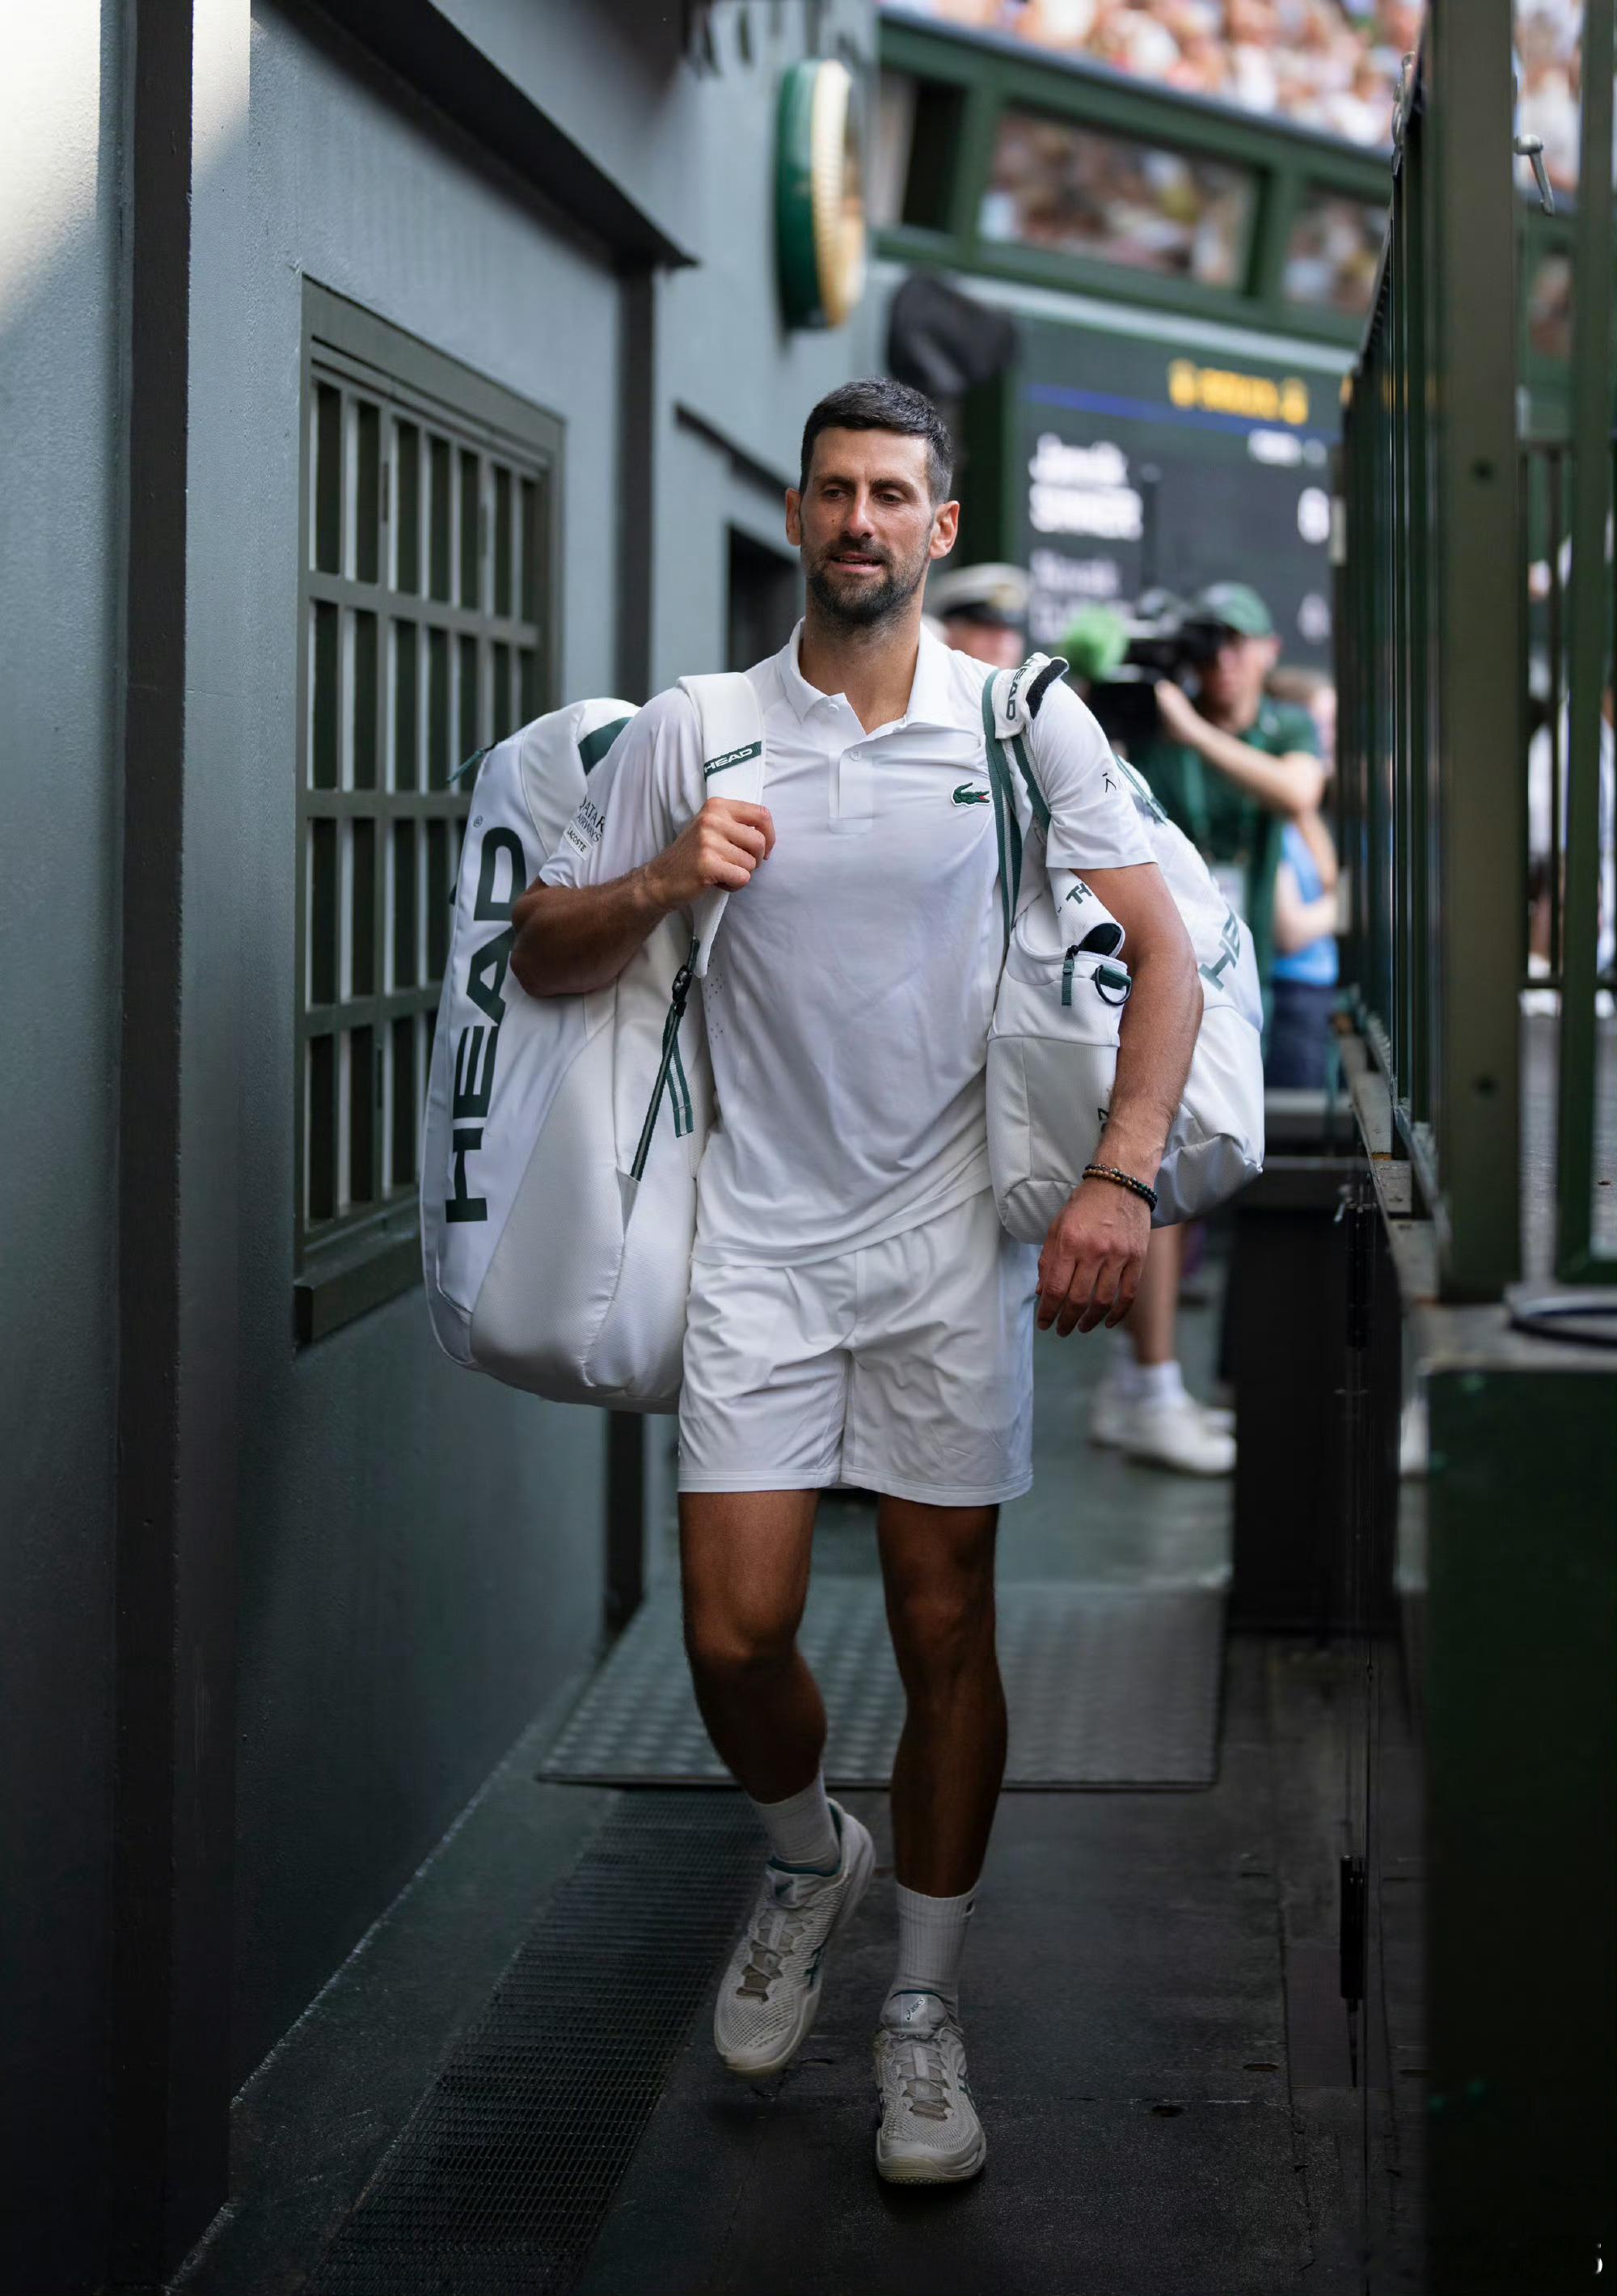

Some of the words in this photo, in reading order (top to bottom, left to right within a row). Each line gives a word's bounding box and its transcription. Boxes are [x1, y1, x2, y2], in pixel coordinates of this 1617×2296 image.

[703, 747, 753, 773] HEAD
[567, 827, 586, 852] LACOSTE
[576, 814, 602, 842] AIRWAYS
[446, 827, 527, 1222] HEAD
